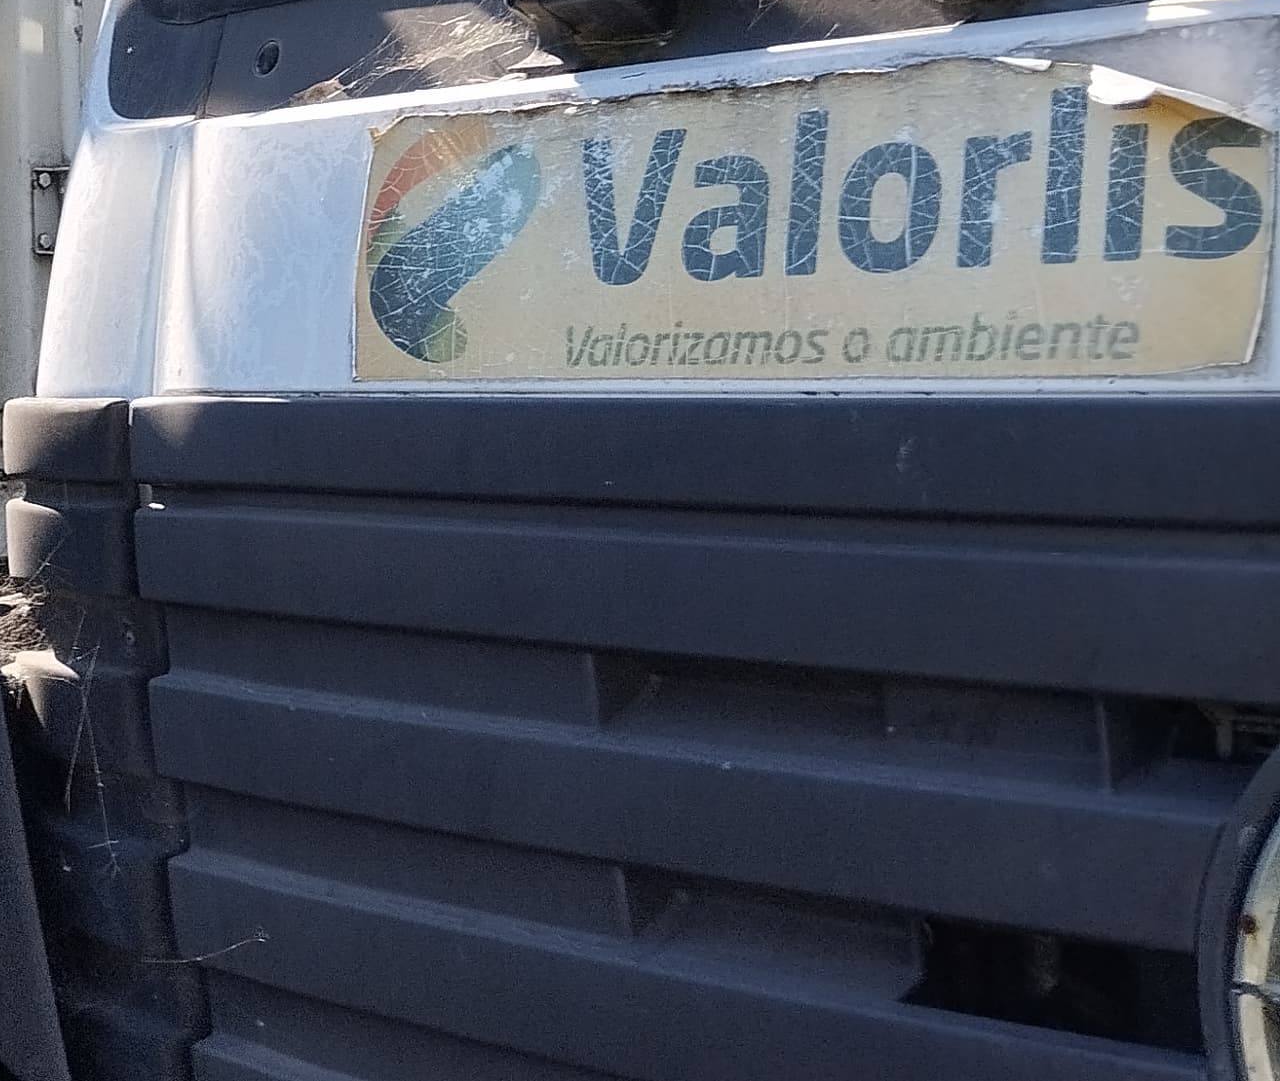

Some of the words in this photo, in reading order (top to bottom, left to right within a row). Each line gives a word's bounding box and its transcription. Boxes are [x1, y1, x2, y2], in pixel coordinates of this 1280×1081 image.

[581, 84, 1264, 286] Valorlis
[566, 321, 828, 367] Valorizamos
[843, 328, 869, 363] o
[887, 313, 1139, 362] ambiente
